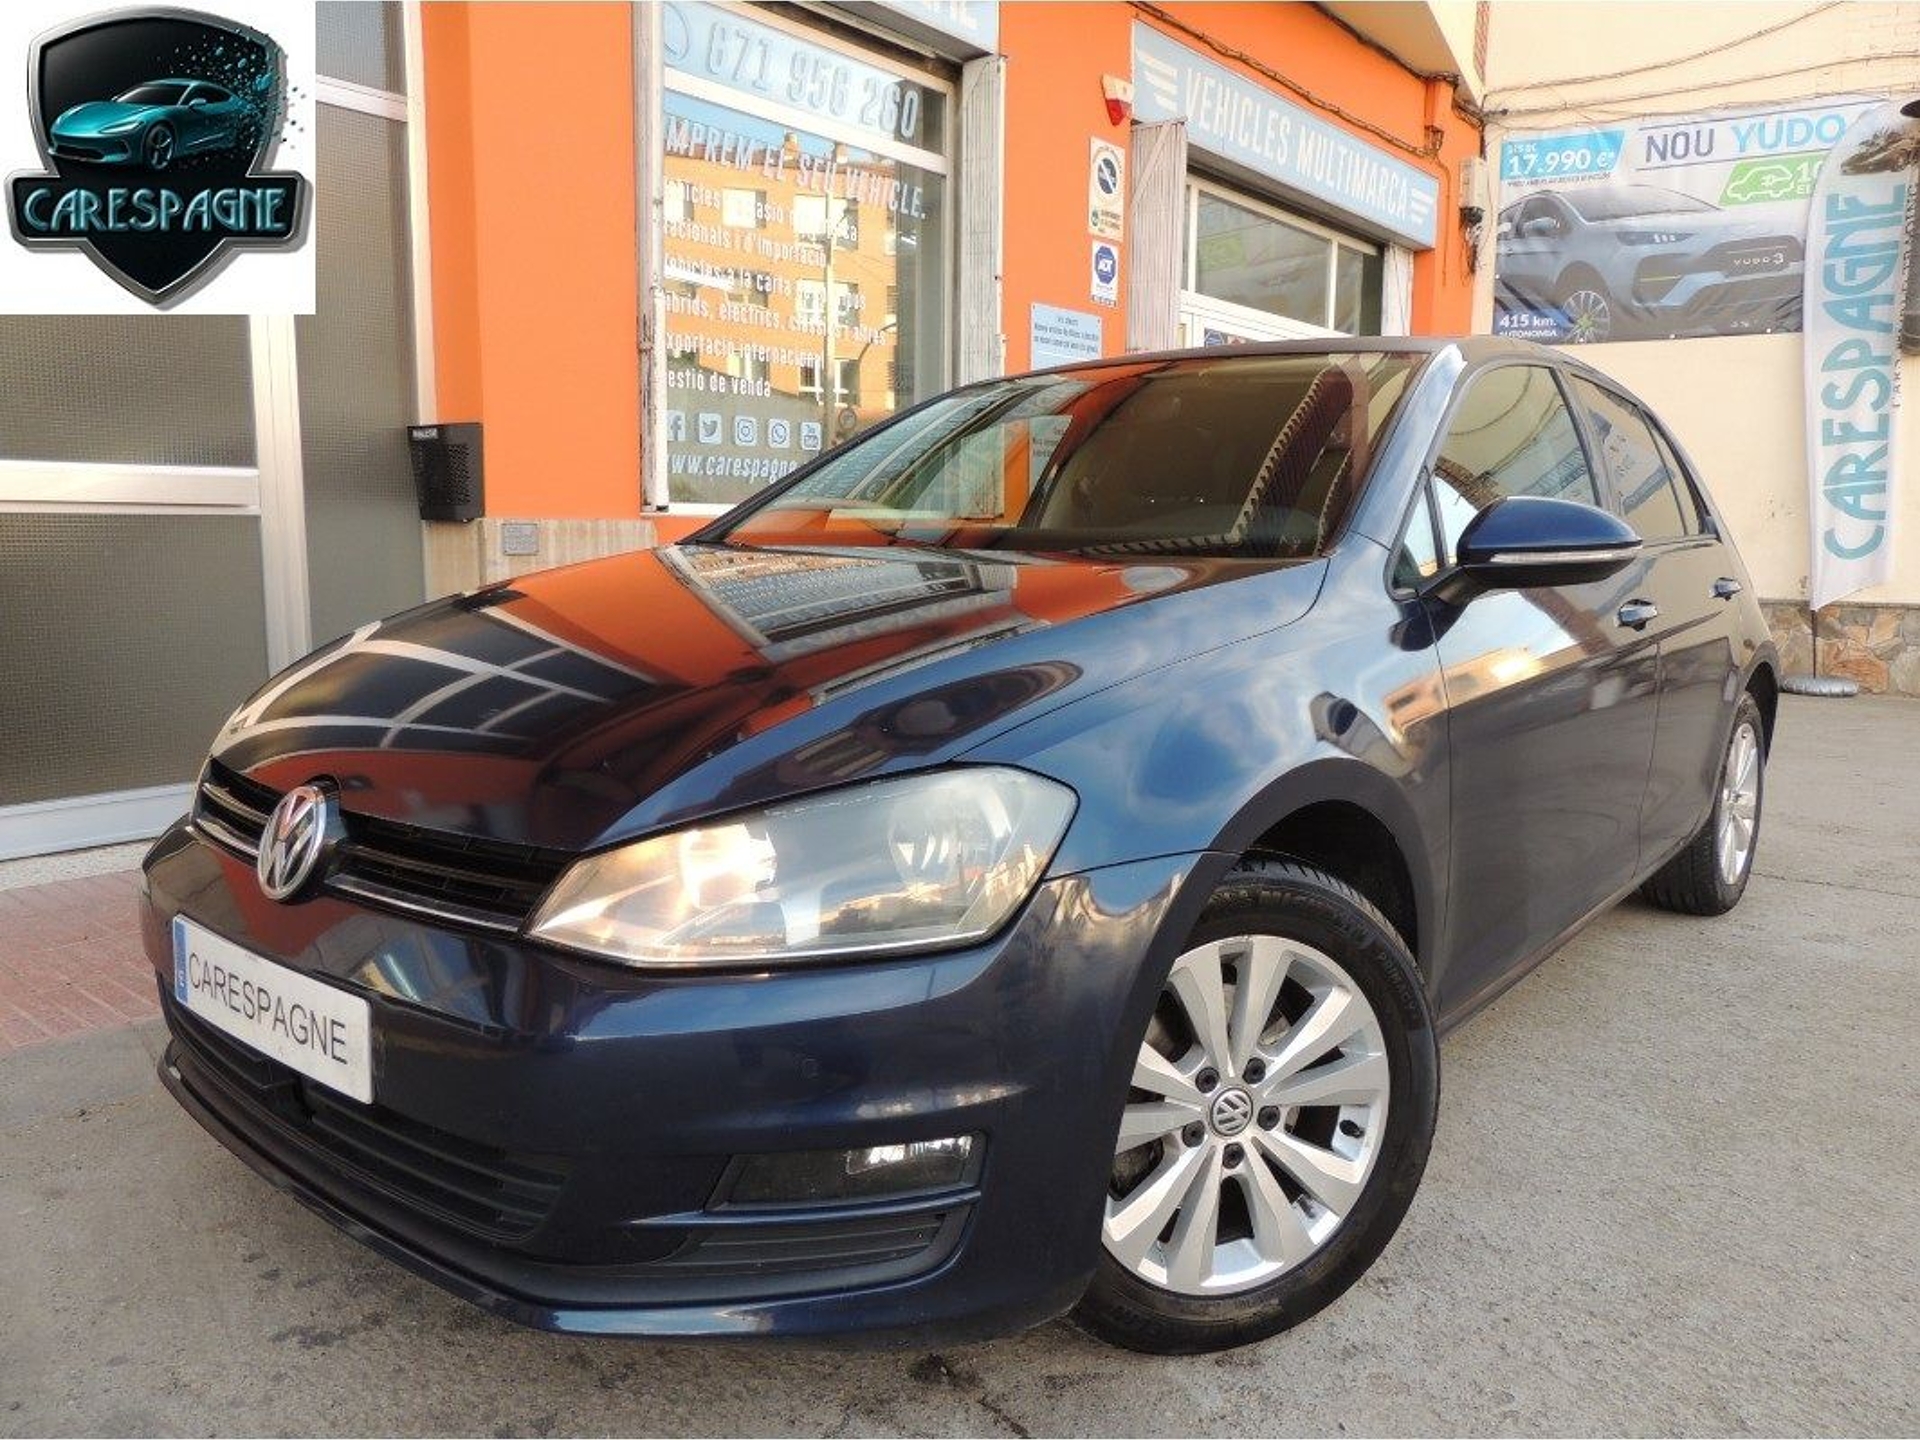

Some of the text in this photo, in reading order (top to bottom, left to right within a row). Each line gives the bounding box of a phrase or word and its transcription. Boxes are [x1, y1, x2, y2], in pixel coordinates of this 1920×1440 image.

[707, 21, 774, 92] 671
[786, 49, 850, 117] 956
[1185, 67, 1409, 221] VEHICLES MULTIMARCA
[1509, 148, 1592, 176] 17.990
[1645, 113, 1846, 163] NOU YUDO
[1500, 313, 1557, 328] 415 km.
[709, 371, 726, 393] de
[731, 377, 772, 398] venda
[1820, 183, 1907, 560] CARESPAGNE
[188, 951, 349, 1066] CARESPAGNE
